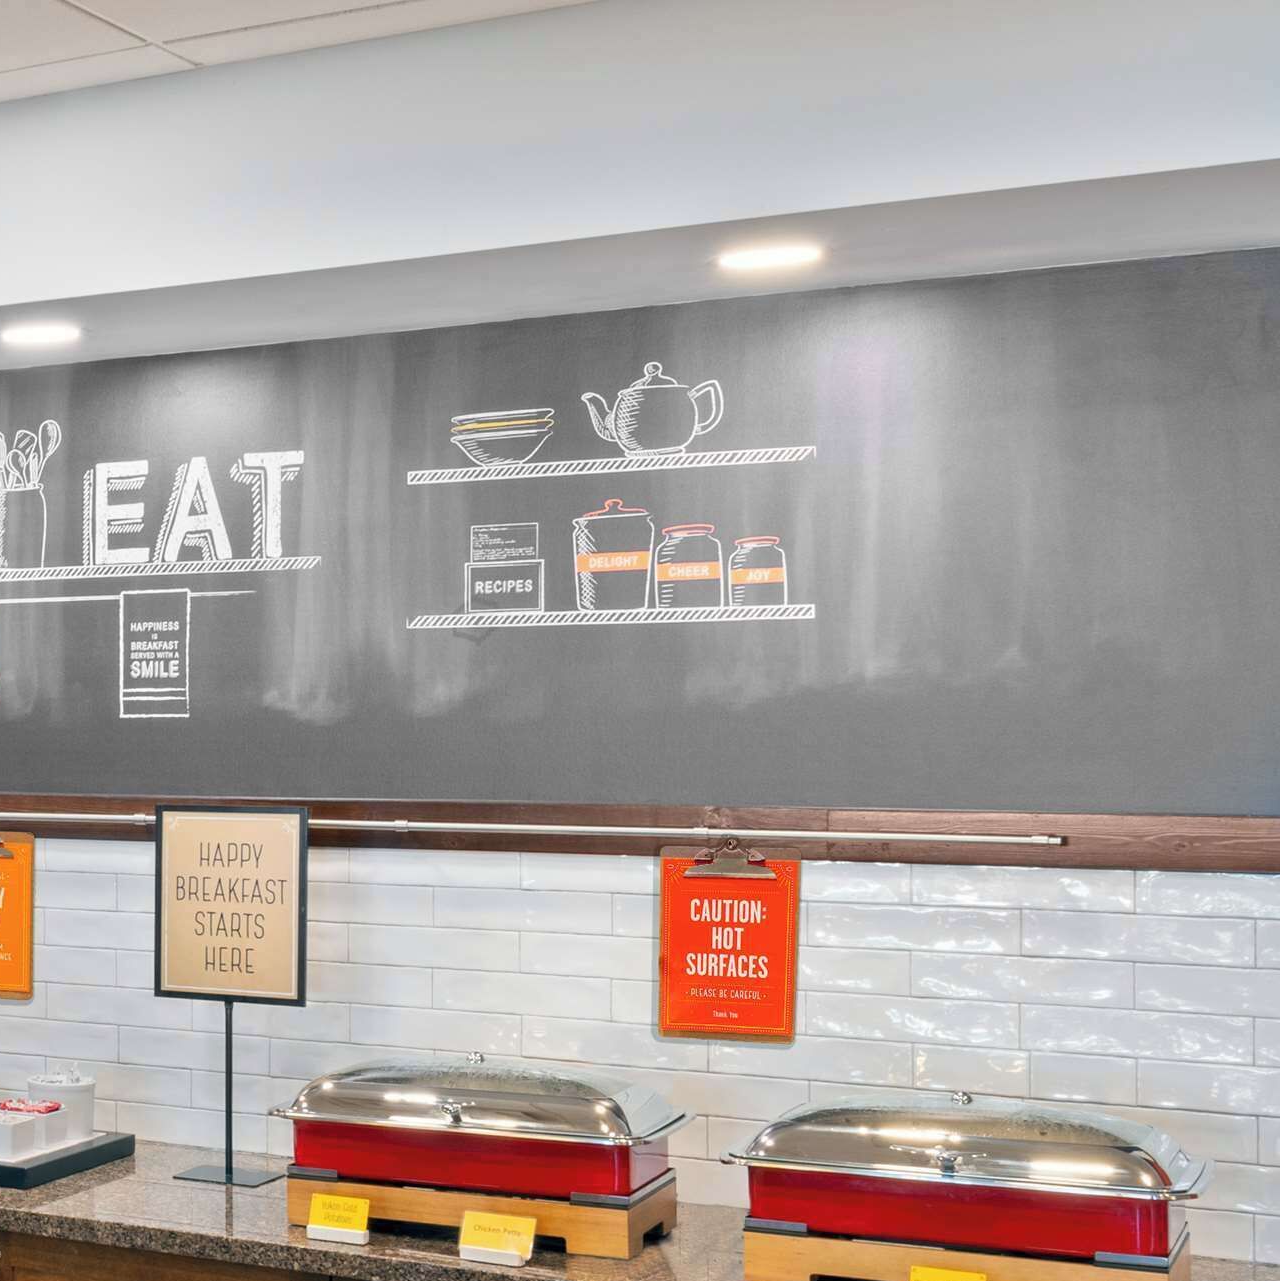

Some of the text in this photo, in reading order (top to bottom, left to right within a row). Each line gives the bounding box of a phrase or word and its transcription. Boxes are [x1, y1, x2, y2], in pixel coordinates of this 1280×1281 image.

[83, 451, 304, 566] EAT
[588, 556, 639, 569] DELIGHT
[668, 567, 710, 578] CHEER
[745, 570, 770, 581] JOY
[474, 579, 533, 595] RECIPES
[130, 620, 179, 632] HAPPINESS
[130, 640, 179, 651] BREAKFAST
[130, 651, 155, 659] SERVED
[156, 651, 173, 659] WITH
[130, 660, 180, 679] SMILE
[199, 842, 264, 868] HAPPY
[176, 876, 287, 905] BREAKFAST
[690, 898, 767, 924] CAUTION:
[194, 911, 265, 939] STARTS
[711, 927, 745, 950] HOT
[204, 945, 255, 974] HERE
[685, 953, 769, 979] SURFACES
[690, 988, 762, 1000] PLEASE BE CAREFUL
